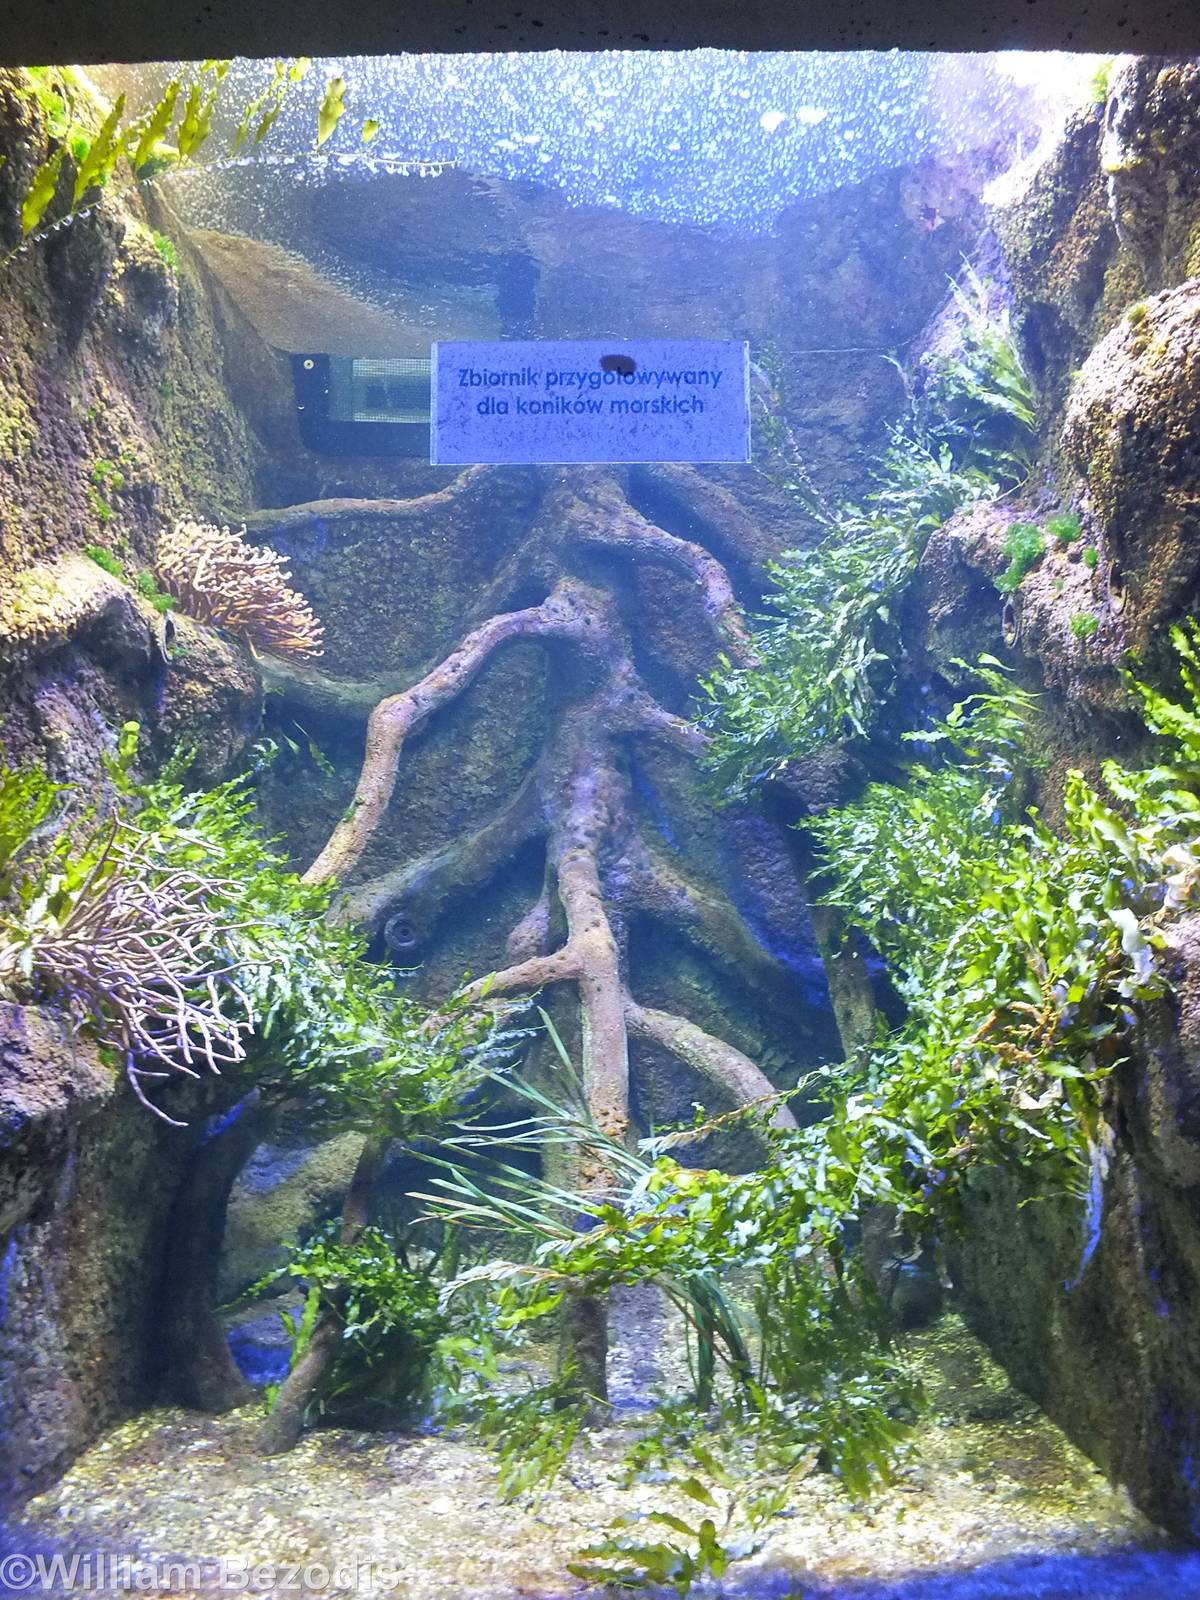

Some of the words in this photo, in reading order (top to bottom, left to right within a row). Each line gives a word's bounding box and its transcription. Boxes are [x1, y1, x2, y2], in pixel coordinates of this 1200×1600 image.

[458, 368, 538, 387] Zbiornik
[476, 397, 509, 415] dla
[517, 394, 603, 415] koników
[610, 395, 704, 414] morskich
